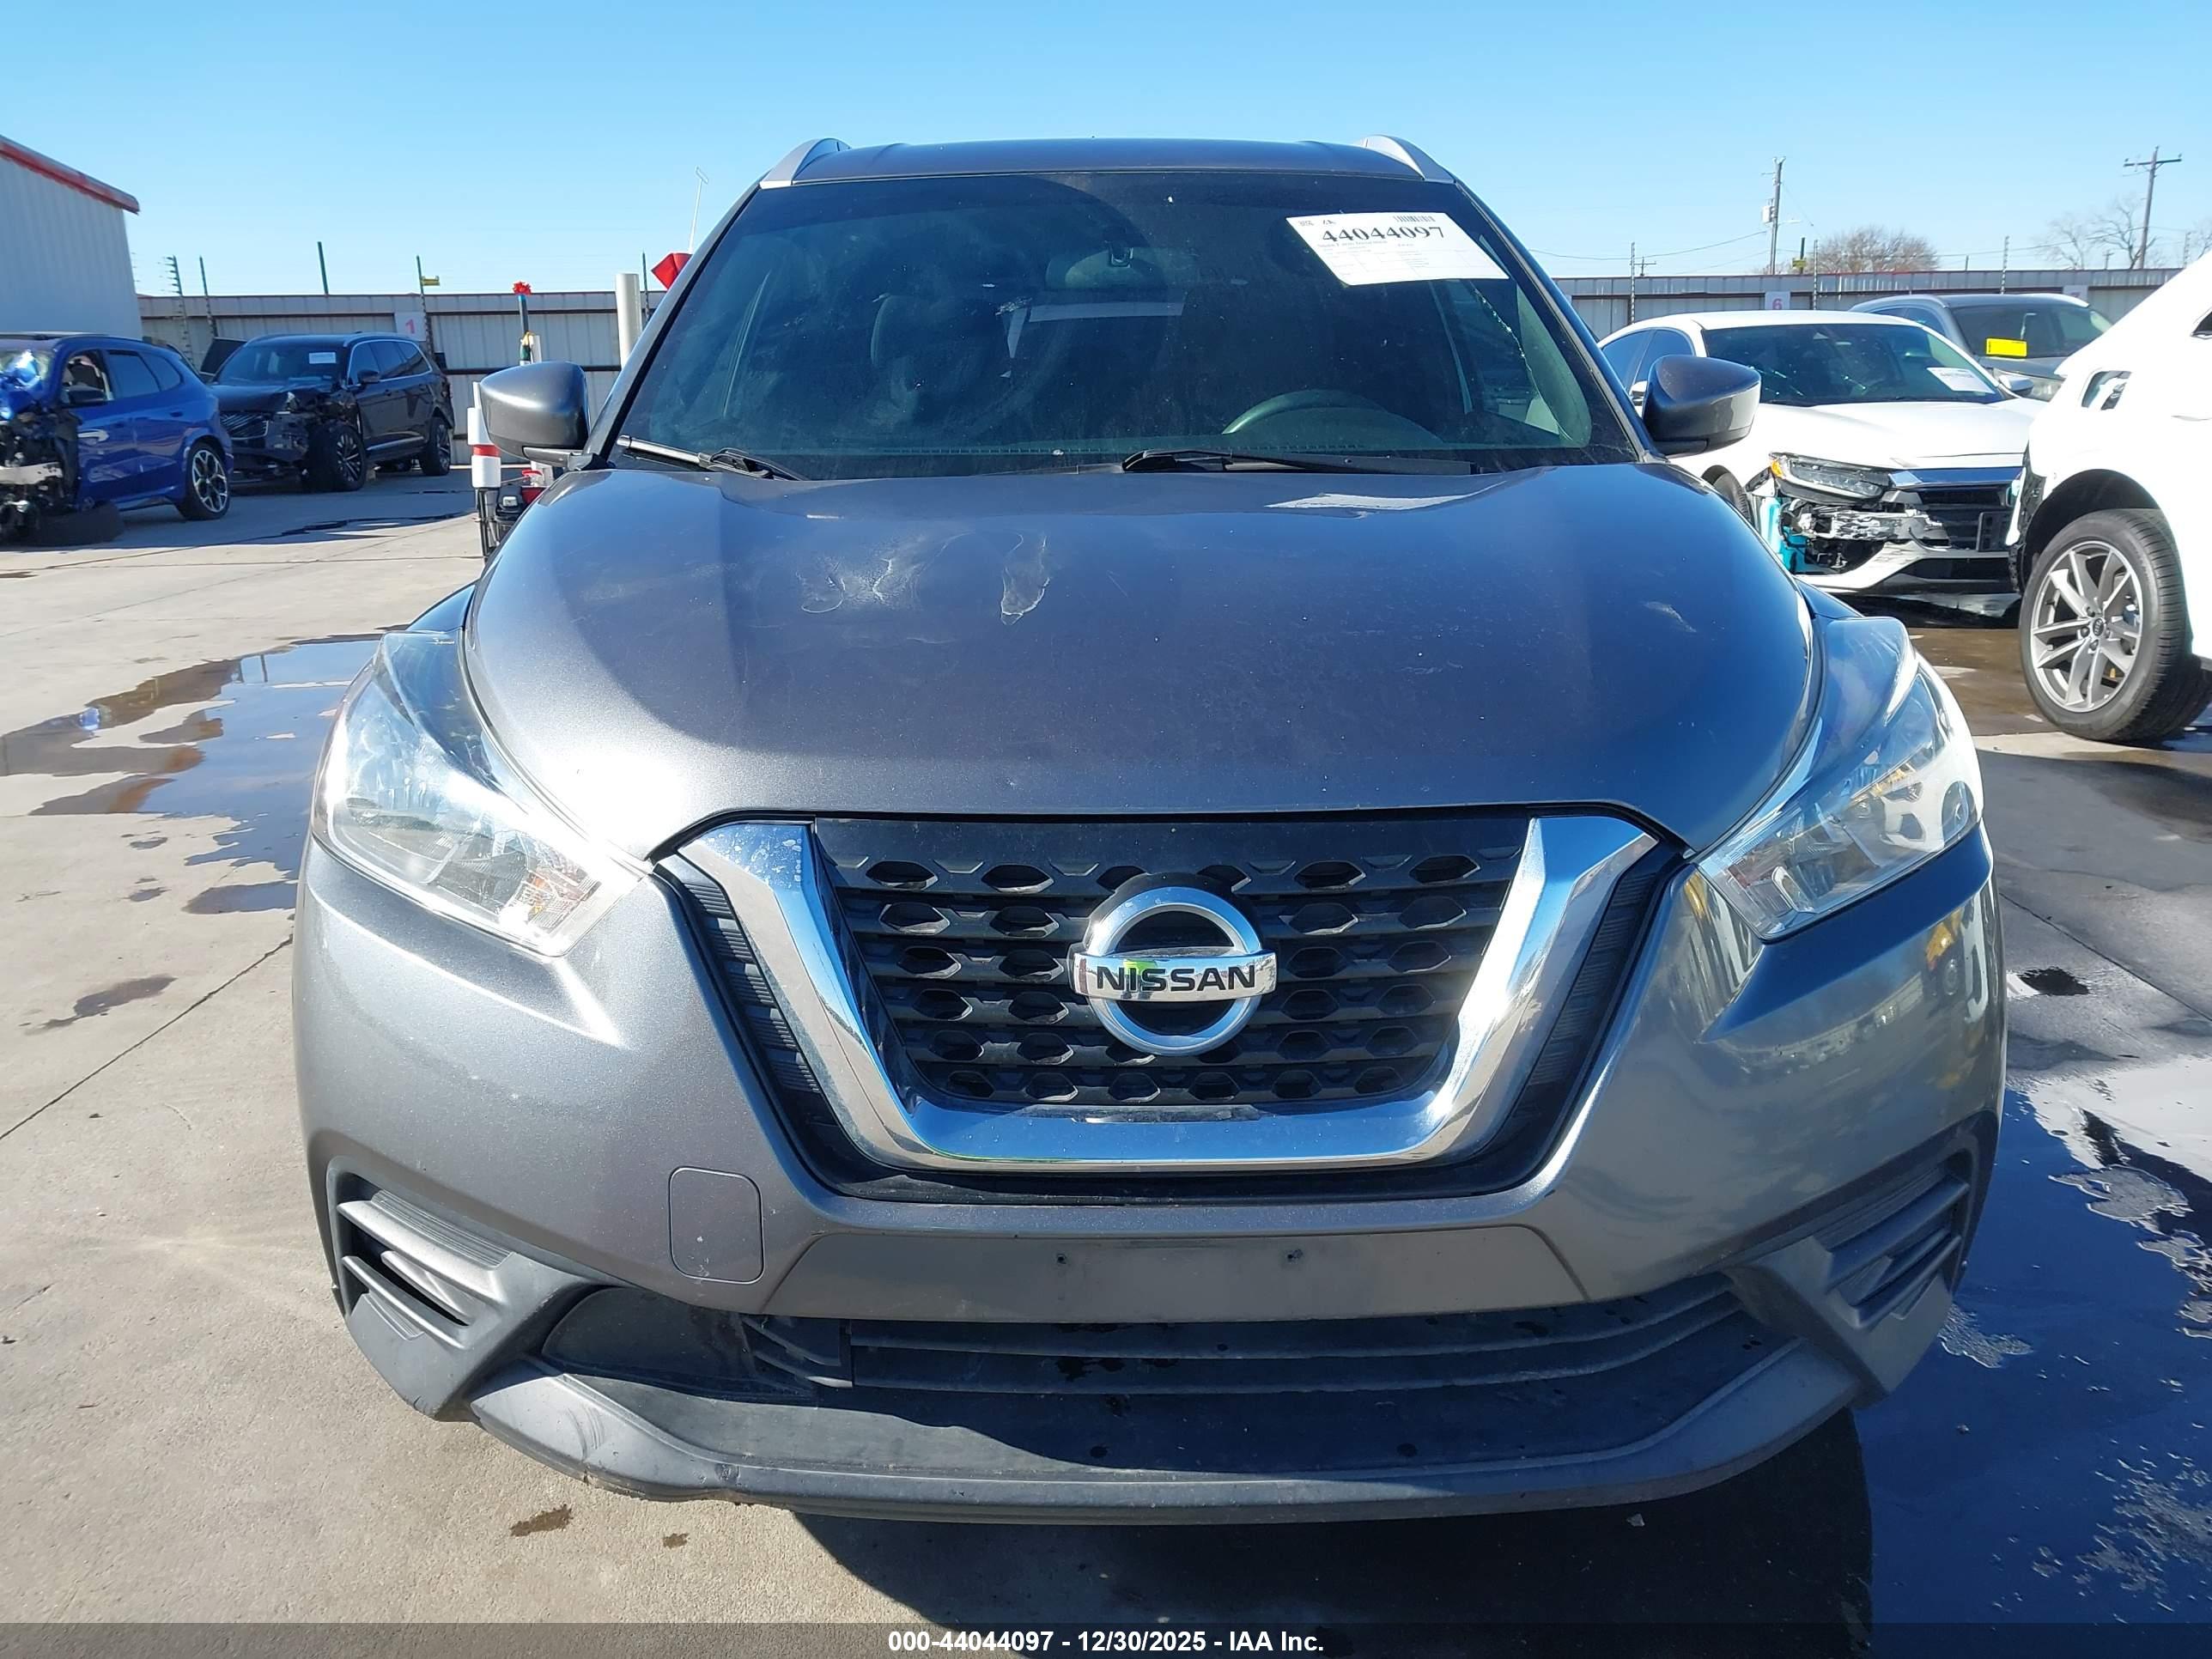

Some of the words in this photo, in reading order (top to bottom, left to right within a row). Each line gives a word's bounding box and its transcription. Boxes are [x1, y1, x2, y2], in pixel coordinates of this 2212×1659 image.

[1322, 226, 1444, 242] 44044097
[405, 319, 415, 334] 1
[1096, 964, 1255, 992] NISSAN
